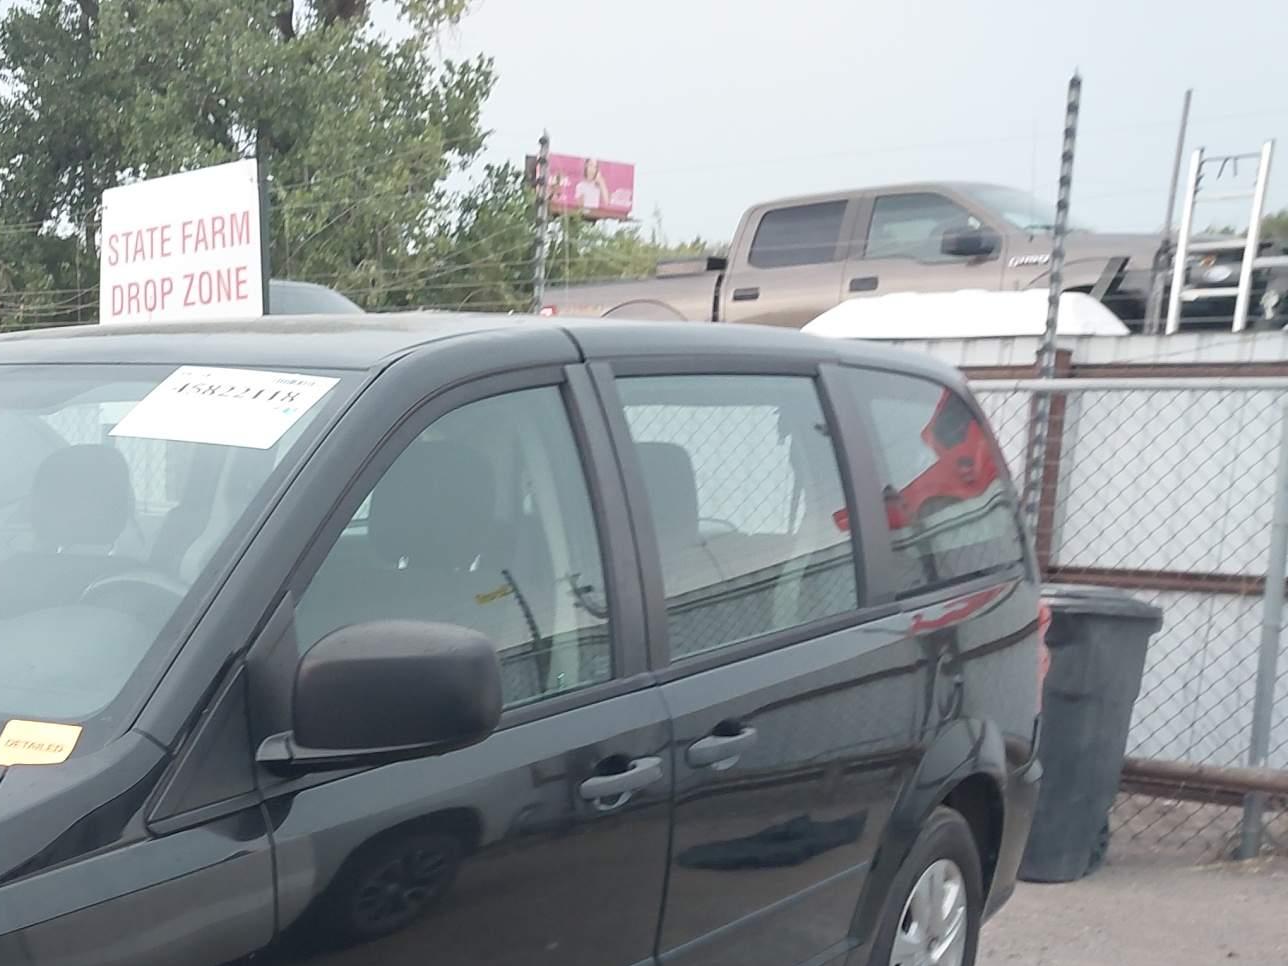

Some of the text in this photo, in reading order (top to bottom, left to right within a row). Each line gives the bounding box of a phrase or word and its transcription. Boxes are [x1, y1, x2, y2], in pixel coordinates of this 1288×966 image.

[107, 210, 251, 266] STATE FARM
[111, 266, 249, 316] DROP ZONE
